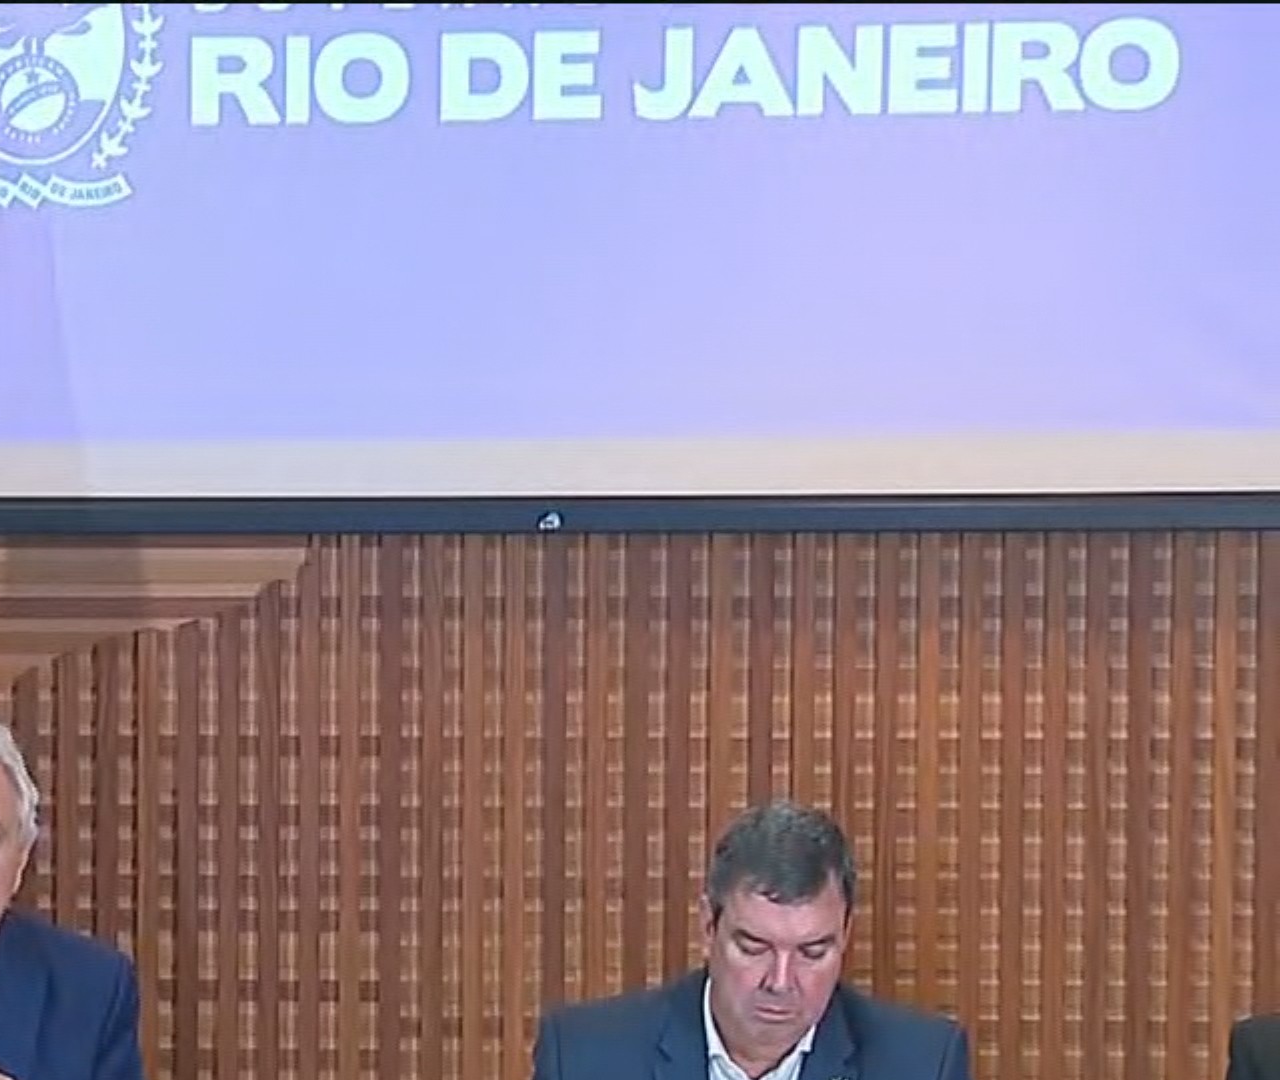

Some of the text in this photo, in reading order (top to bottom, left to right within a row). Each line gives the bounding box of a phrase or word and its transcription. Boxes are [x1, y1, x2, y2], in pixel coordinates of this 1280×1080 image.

[190, 31, 411, 127] RIO
[439, 30, 602, 124] DE
[633, 21, 1181, 121] JANEIRO
